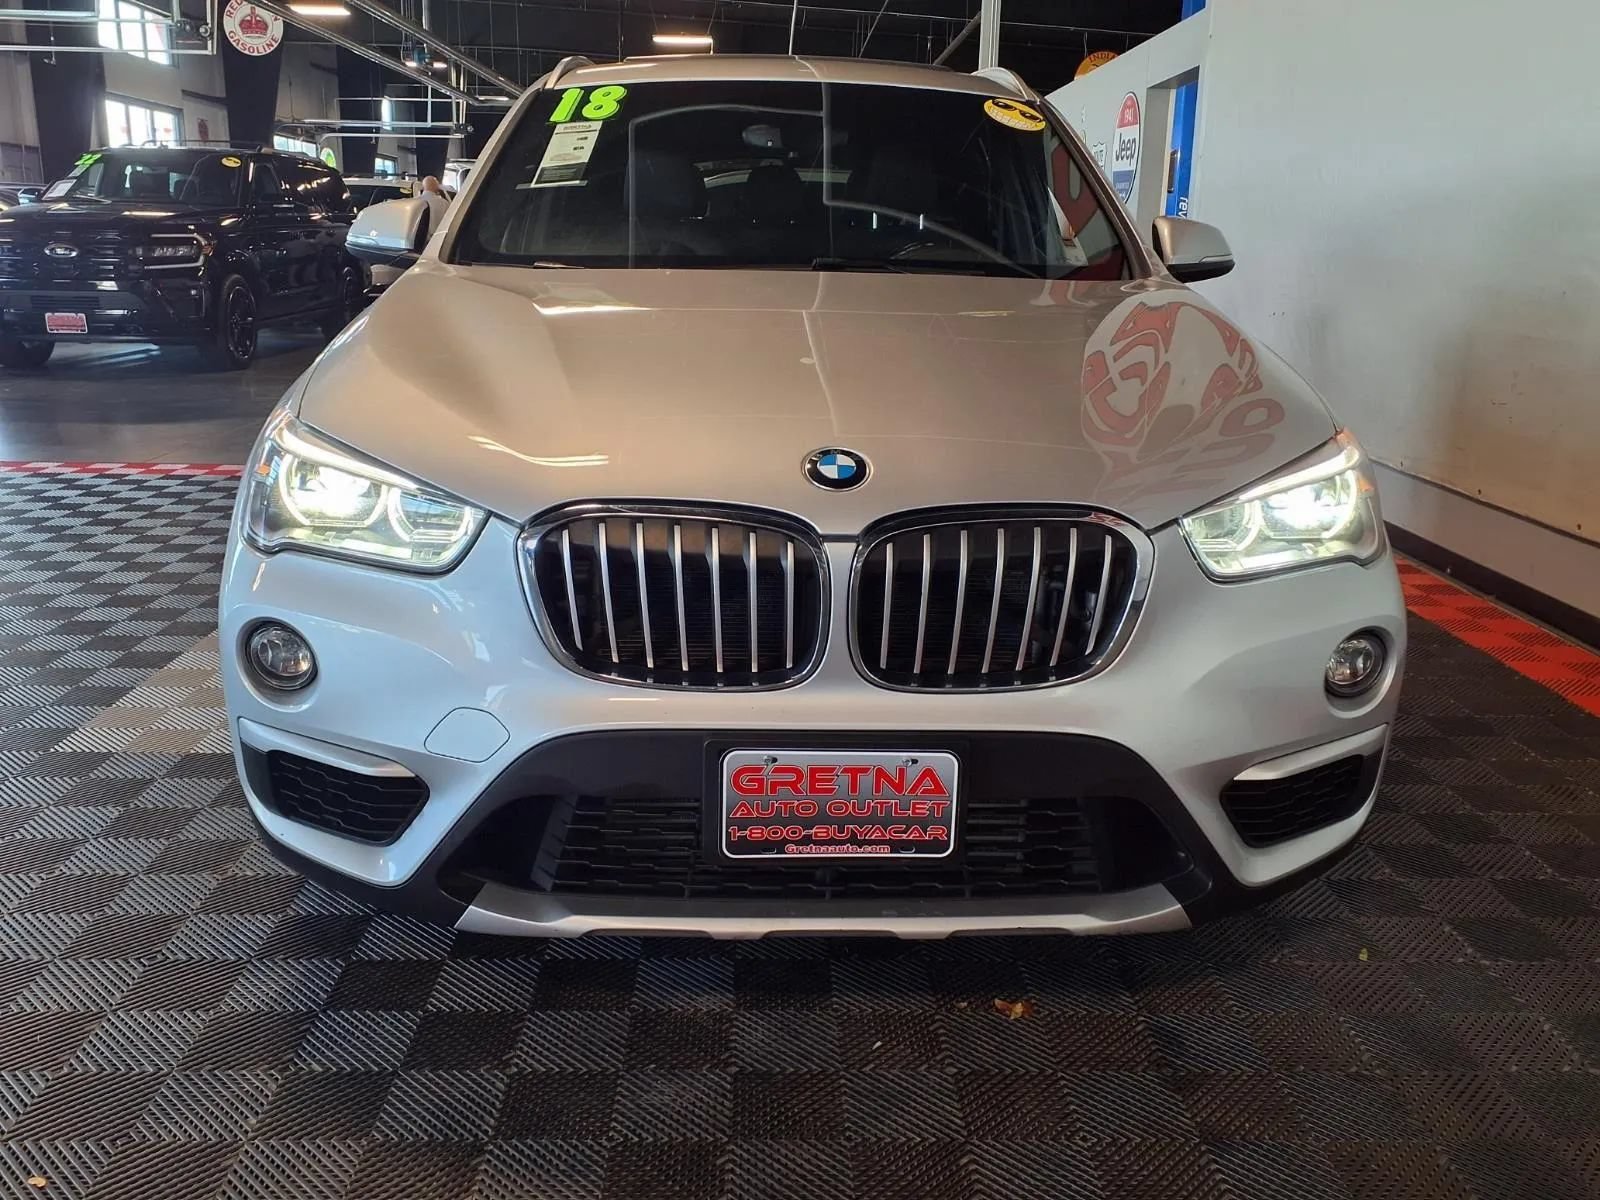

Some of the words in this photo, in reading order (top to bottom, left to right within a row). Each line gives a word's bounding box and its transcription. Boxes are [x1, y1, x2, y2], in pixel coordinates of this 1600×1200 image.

[228, 31, 280, 54] GASOLINE
[549, 85, 628, 122] 18
[1115, 133, 1136, 166] Jeep
[730, 764, 950, 797] GRETNA
[729, 799, 819, 818] AUTO
[826, 799, 950, 818] OUTLET
[728, 825, 948, 841] 1-800-BUYACAR
[784, 843, 891, 855] Gretnaauto.com
